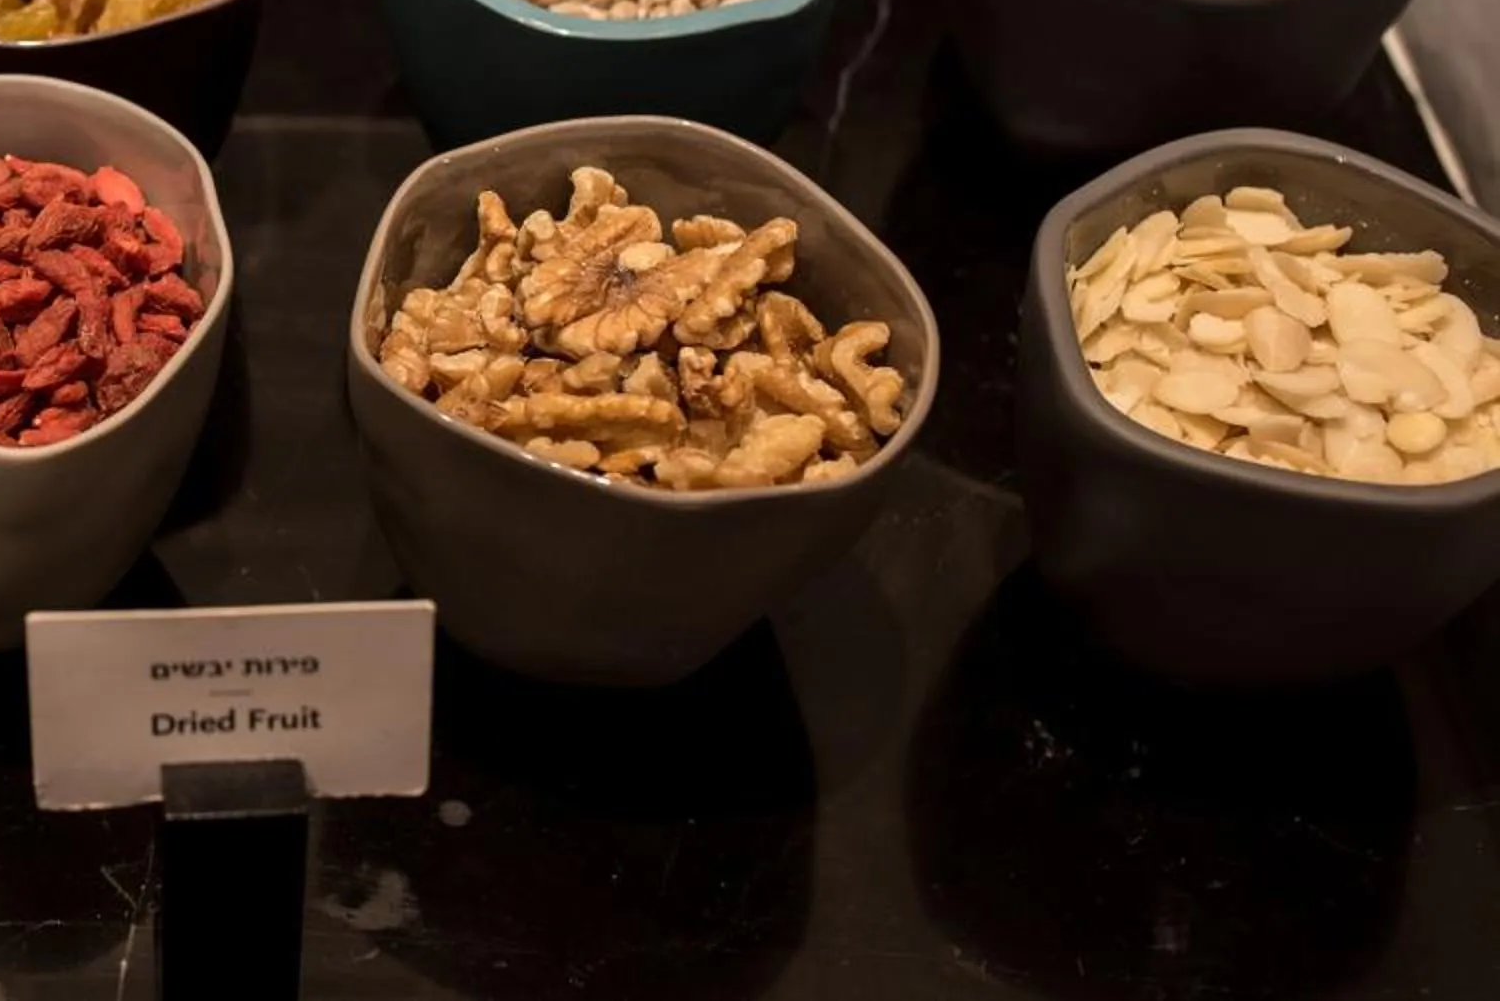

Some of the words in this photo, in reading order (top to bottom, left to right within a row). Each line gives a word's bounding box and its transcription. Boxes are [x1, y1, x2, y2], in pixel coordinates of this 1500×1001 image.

[149, 660, 233, 681] יבשים
[242, 654, 320, 677] פירות
[149, 707, 237, 736] Dried
[248, 705, 323, 732] Fruit
